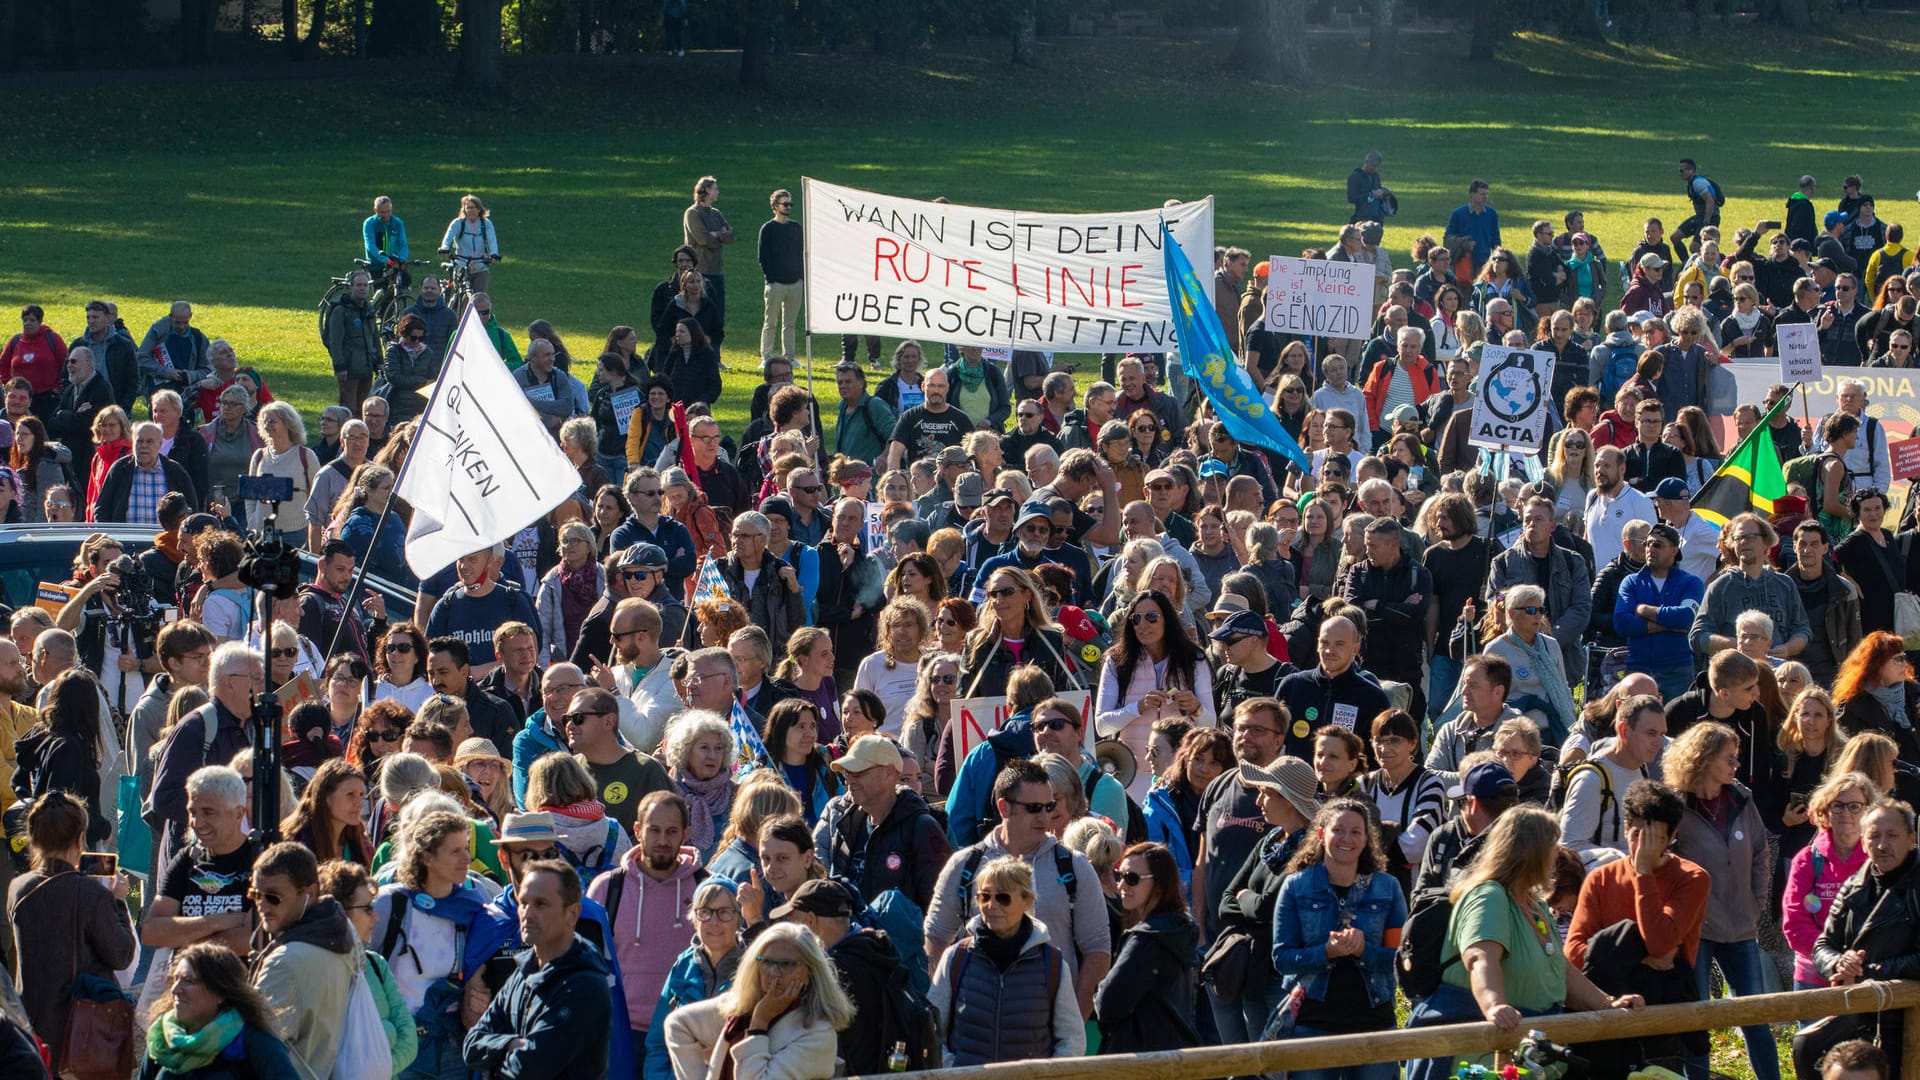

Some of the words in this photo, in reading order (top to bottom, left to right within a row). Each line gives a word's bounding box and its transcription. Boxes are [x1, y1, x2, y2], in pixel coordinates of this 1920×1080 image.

[838, 199, 944, 243] WANN
[970, 219, 1043, 251] IST
[1271, 257, 1288, 273] Die
[1294, 259, 1351, 284] Impfung
[1013, 263, 1143, 307] LINIE
[1291, 279, 1304, 290] ist
[1291, 291, 1306, 303] ist
[1271, 303, 1360, 334] GENOZID
[1478, 422, 1535, 443] ACTA
[183, 895, 202, 905] FOR
[203, 894, 242, 905] JUSTICE
[182, 905, 202, 916] FOR
